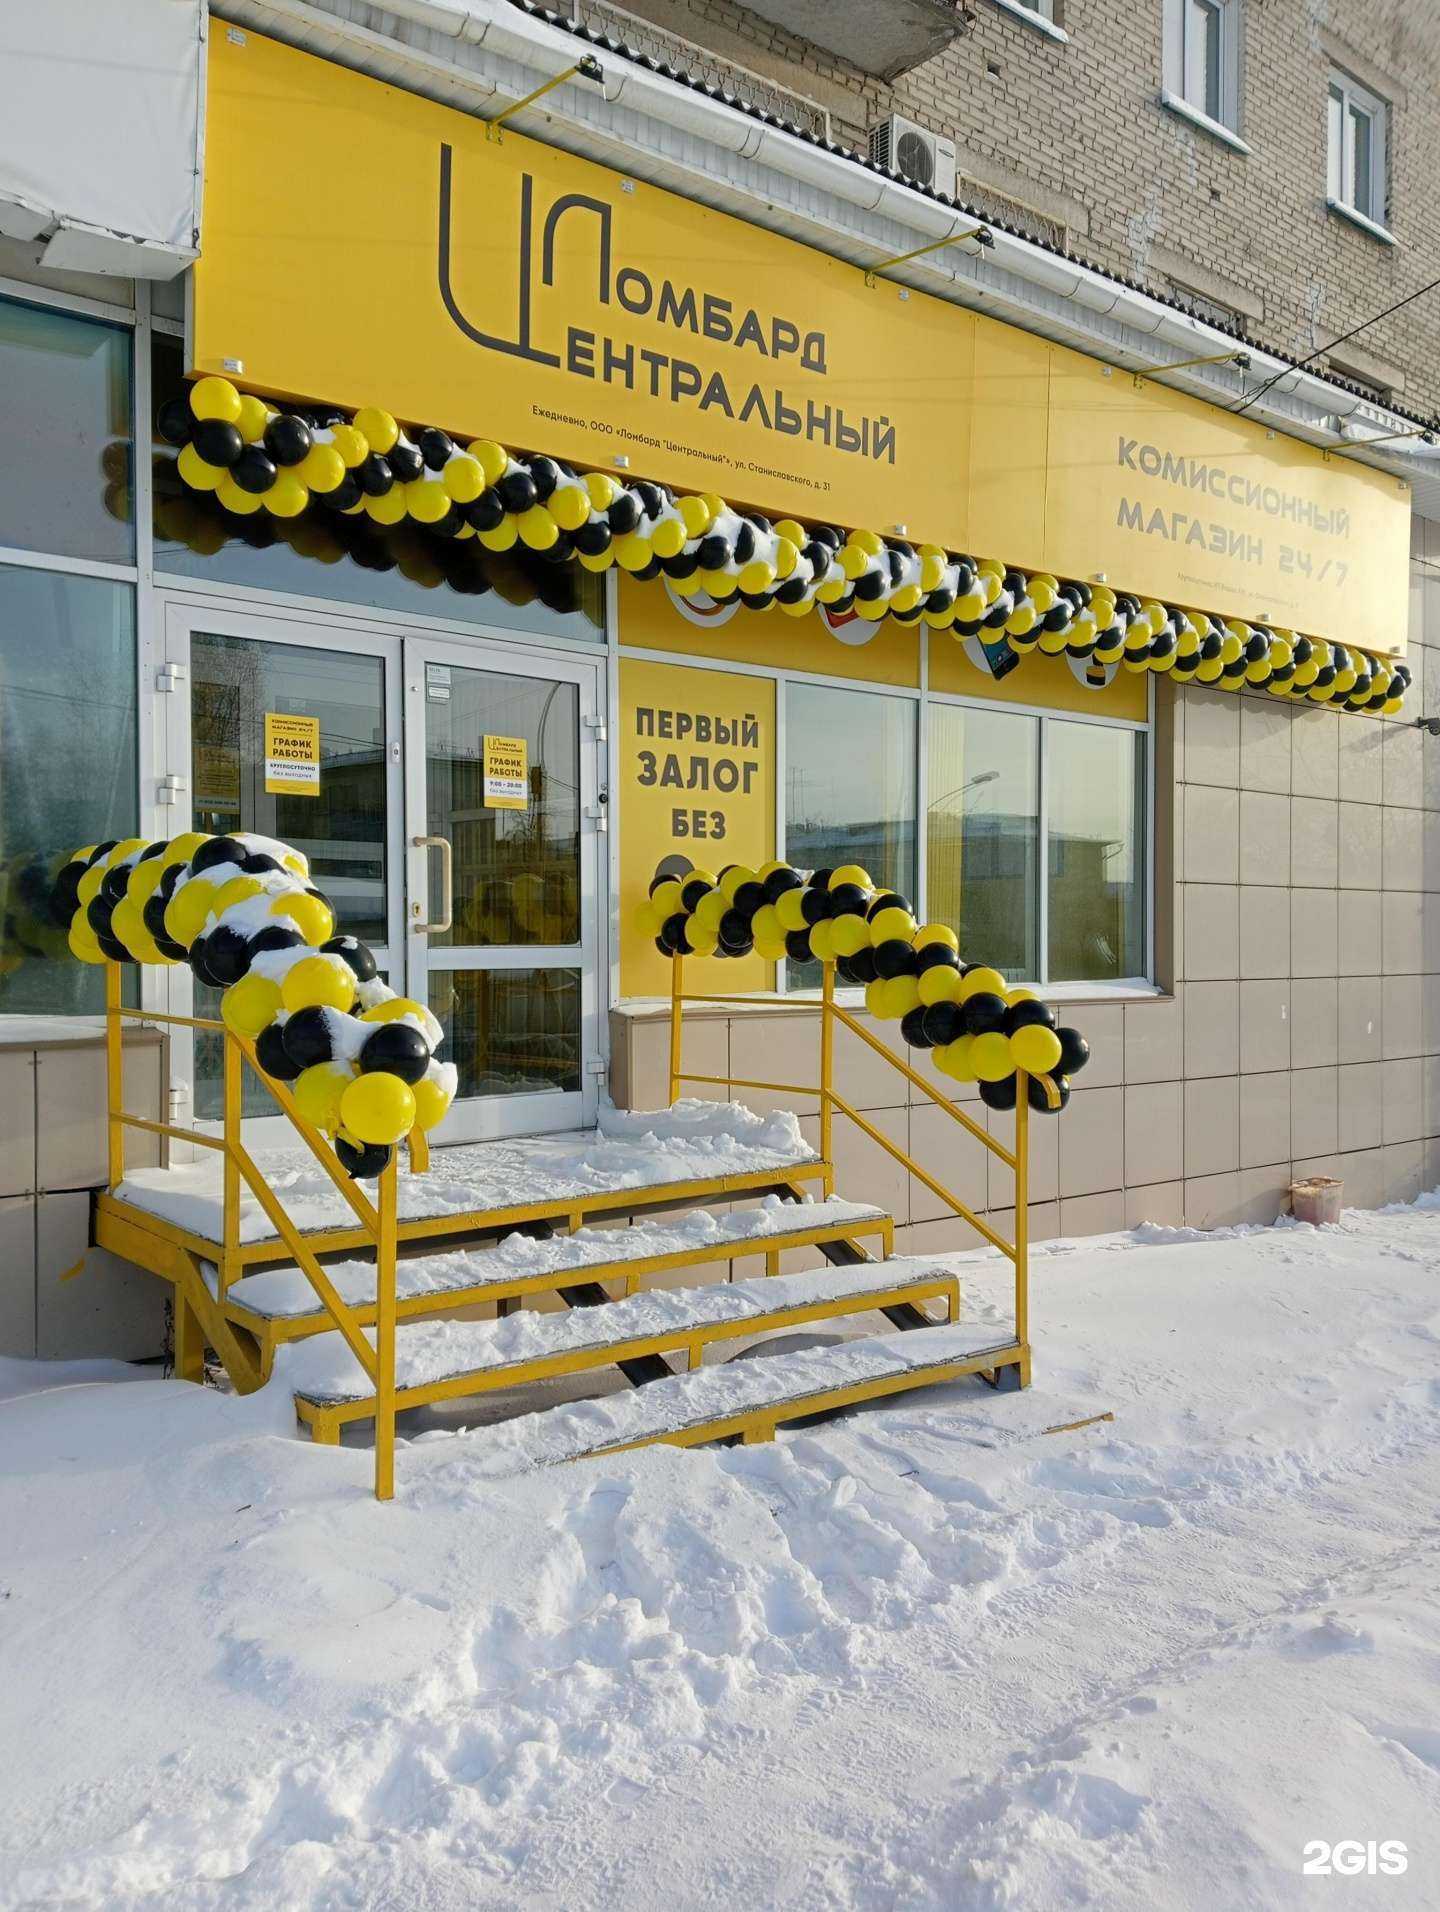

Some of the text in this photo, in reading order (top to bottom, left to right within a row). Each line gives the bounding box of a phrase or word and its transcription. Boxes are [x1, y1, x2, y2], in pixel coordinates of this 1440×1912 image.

[532, 405, 588, 429] Ежедневно,
[590, 420, 613, 434] ООО
[616, 428, 661, 448] «Ломбард
[735, 460, 747, 470] ул.
[748, 462, 813, 487] Станиславского,
[814, 482, 822, 490] д.
[823, 481, 831, 491] 31
[1118, 436, 1350, 539] КОМИССИОННЫЙ
[1117, 497, 1348, 588] МАГАЗИН 24/7
[273, 737, 312, 748] ГРАФИК
[636, 707, 758, 748] ПЕРВЫЙ
[273, 748, 313, 759] РАБОТЫ
[490, 757, 522, 767] ГРАФИК
[489, 767, 522, 777] РАБОТЫ
[637, 750, 758, 794] ЗАЛОГ
[672, 808, 726, 840] БЕЗ
